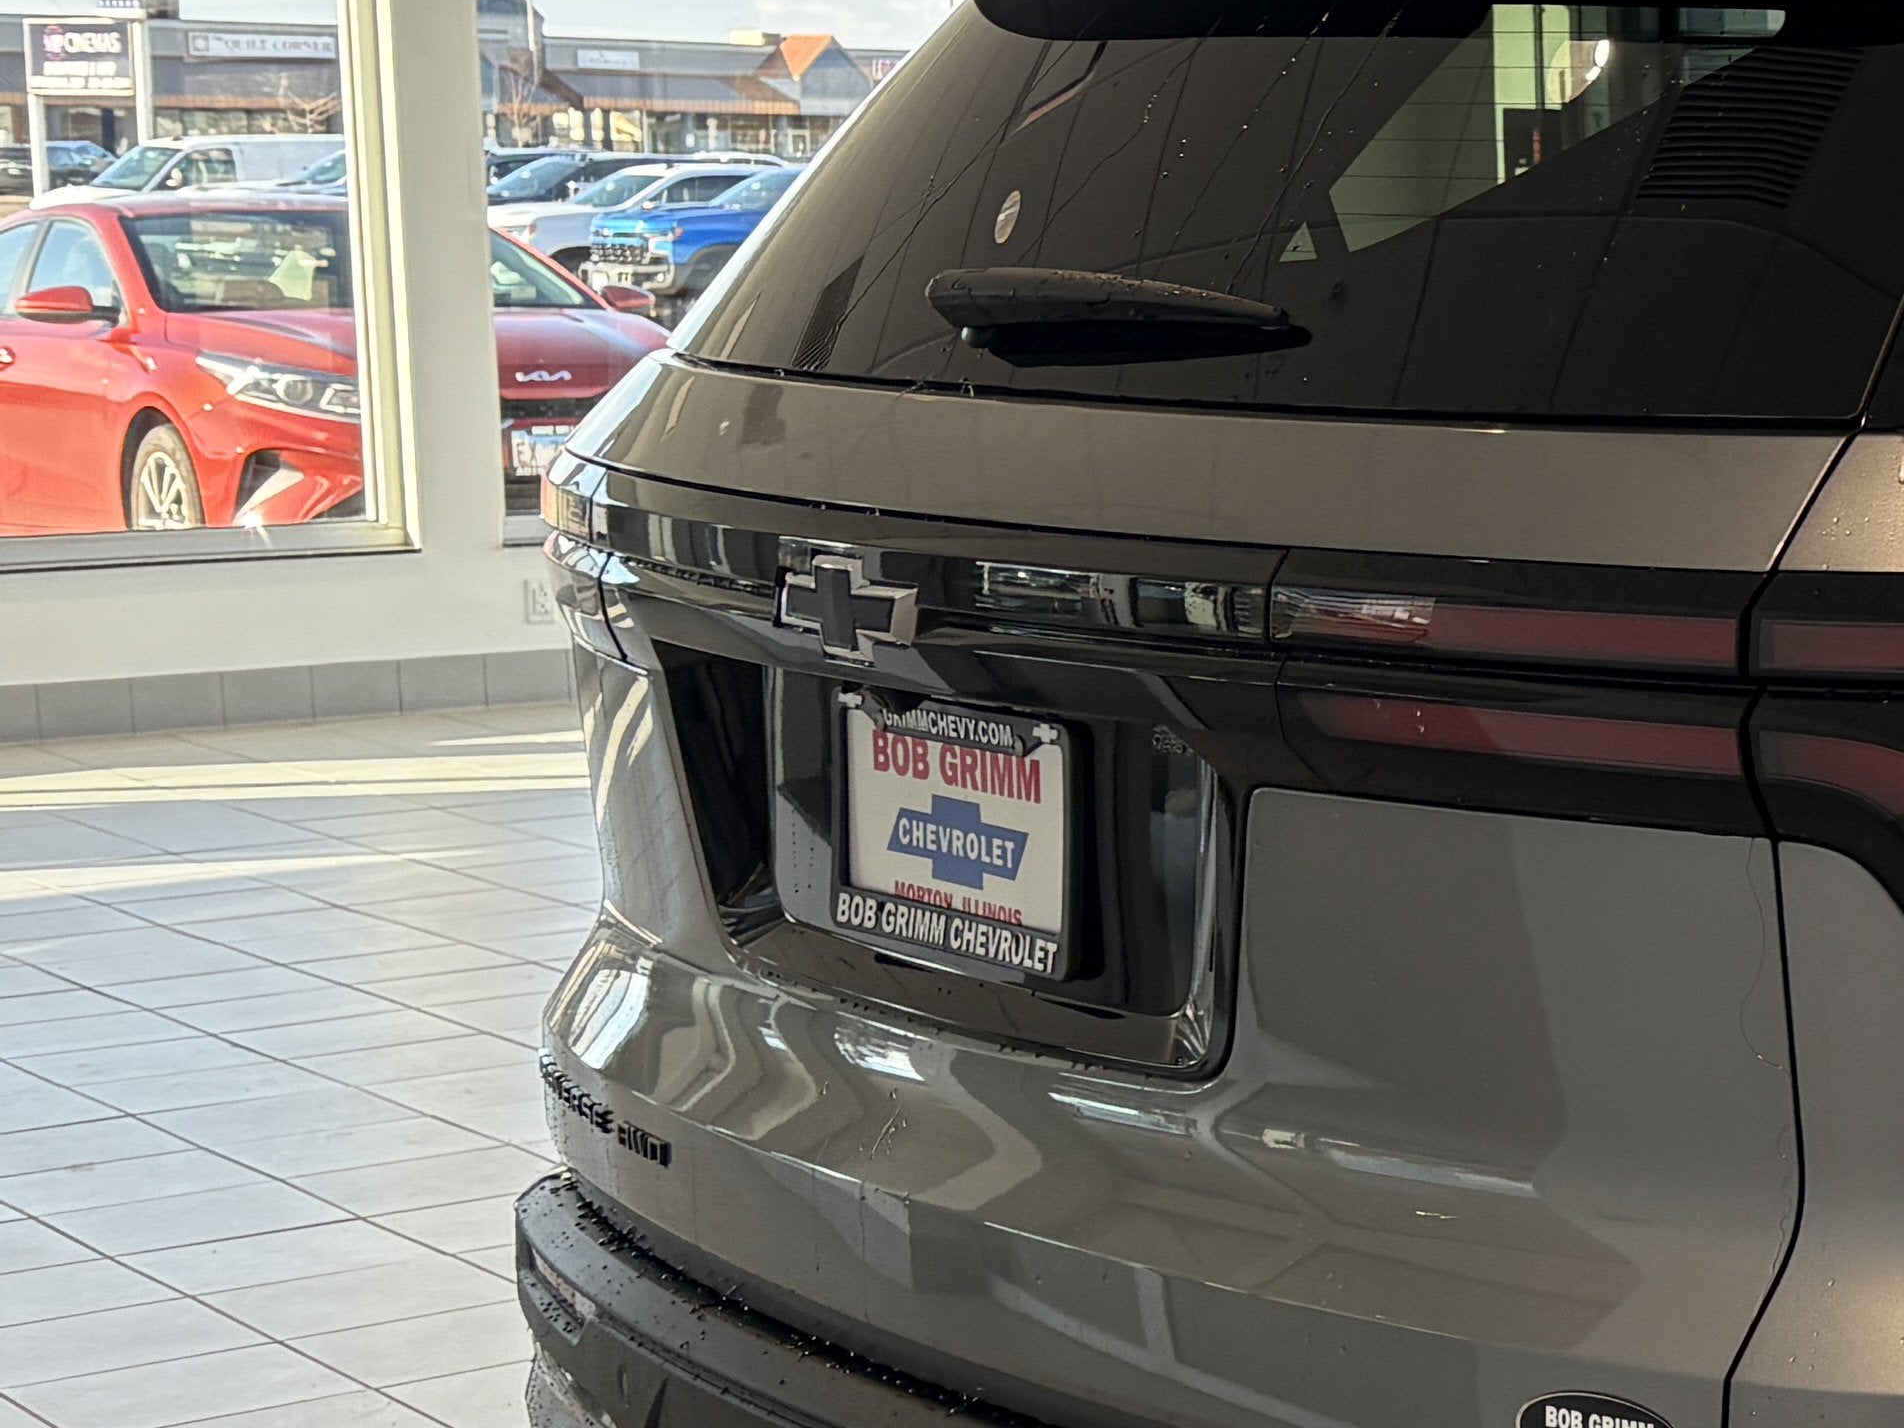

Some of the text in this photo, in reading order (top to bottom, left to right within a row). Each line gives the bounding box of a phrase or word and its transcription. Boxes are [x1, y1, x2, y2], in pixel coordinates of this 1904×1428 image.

[873, 729, 1041, 804] BOB GRIMM
[898, 817, 1015, 869] CHEVROLET
[836, 892, 1058, 973] BOB GRIMM CHEVROLET
